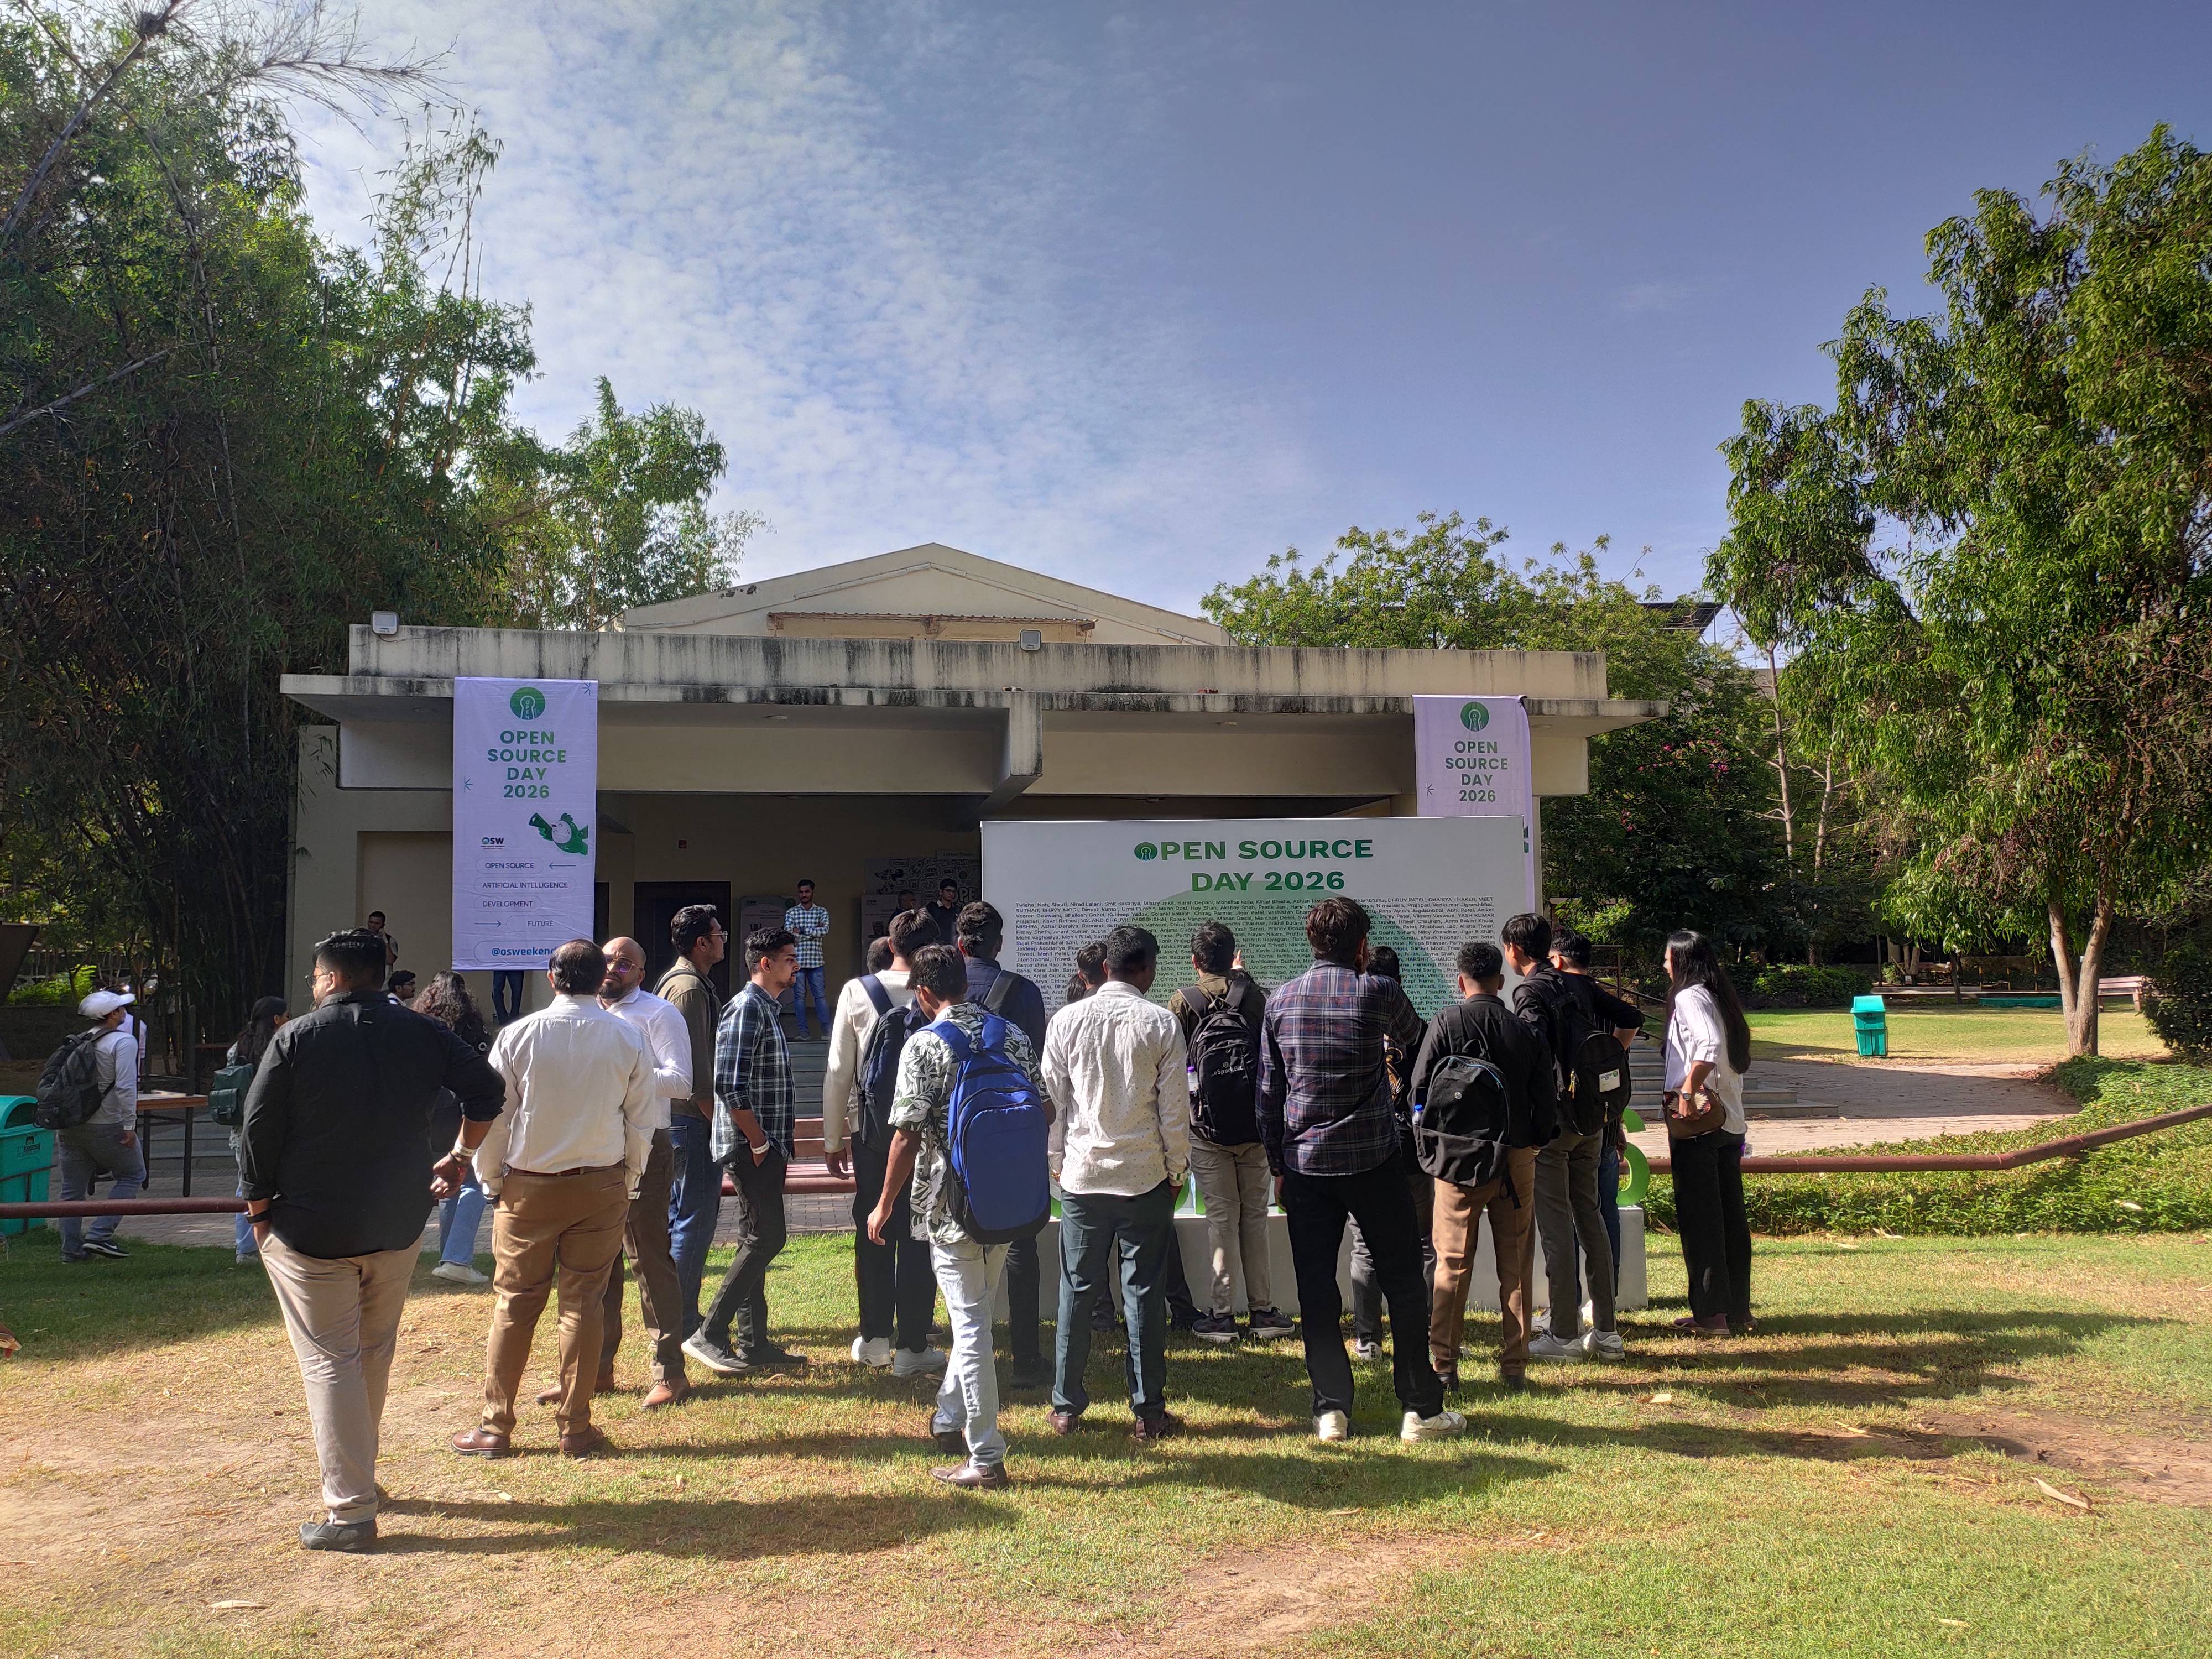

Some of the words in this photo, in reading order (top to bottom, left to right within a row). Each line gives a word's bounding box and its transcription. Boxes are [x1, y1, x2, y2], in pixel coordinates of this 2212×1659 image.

[500, 730, 554, 745] OPEN
[1454, 740, 1497, 754] OPEN
[488, 749, 566, 763] SOURCE
[1445, 758, 1508, 770] SOURCE
[507, 767, 547, 780] DAY
[1461, 774, 1493, 786] DAY
[504, 785, 549, 798] 2026
[1459, 790, 1496, 802] 2026
[1238, 839, 1374, 859] SOURCE
[1192, 872, 1254, 891] DAY
[1264, 870, 1345, 890] 2026
